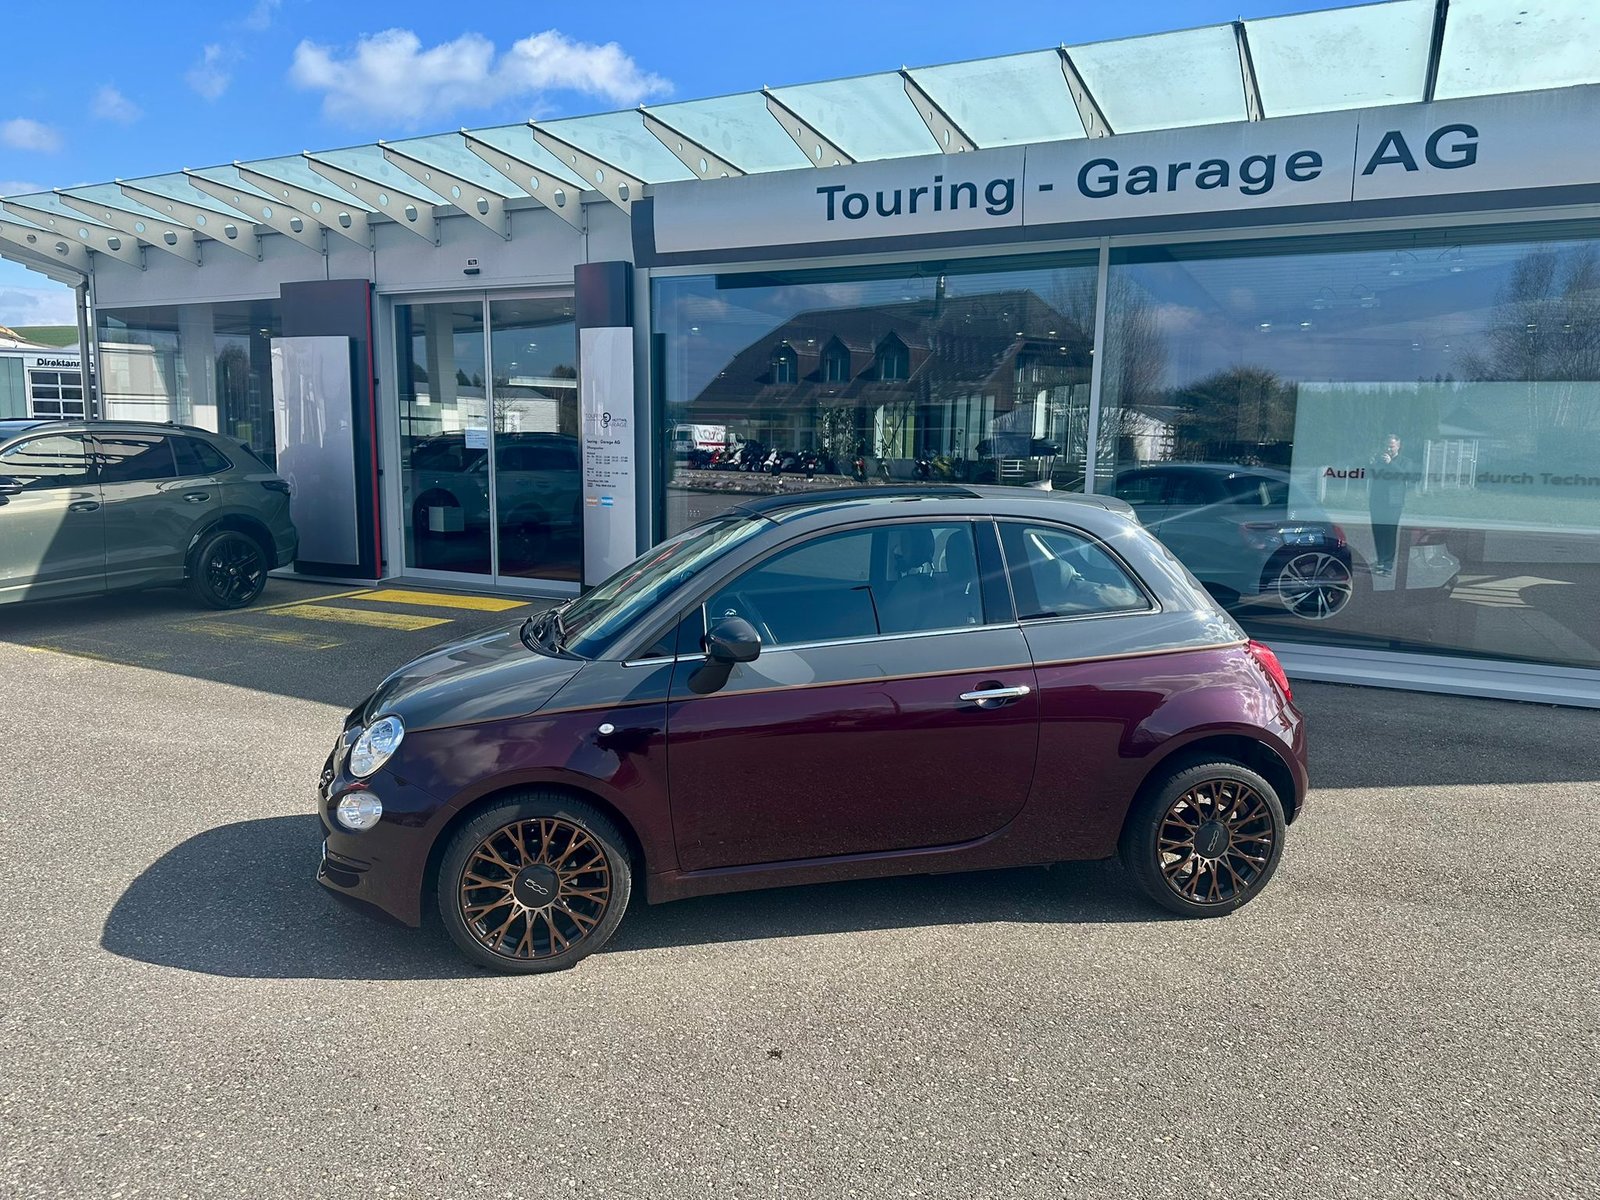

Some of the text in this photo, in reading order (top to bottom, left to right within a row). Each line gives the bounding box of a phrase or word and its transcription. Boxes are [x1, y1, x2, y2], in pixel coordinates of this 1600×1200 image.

[816, 174, 1016, 221] Touring
[1077, 150, 1323, 199] Garage
[1361, 123, 1479, 176] AG
[1323, 466, 1365, 479] Audi
[1477, 471, 1534, 484] durch
